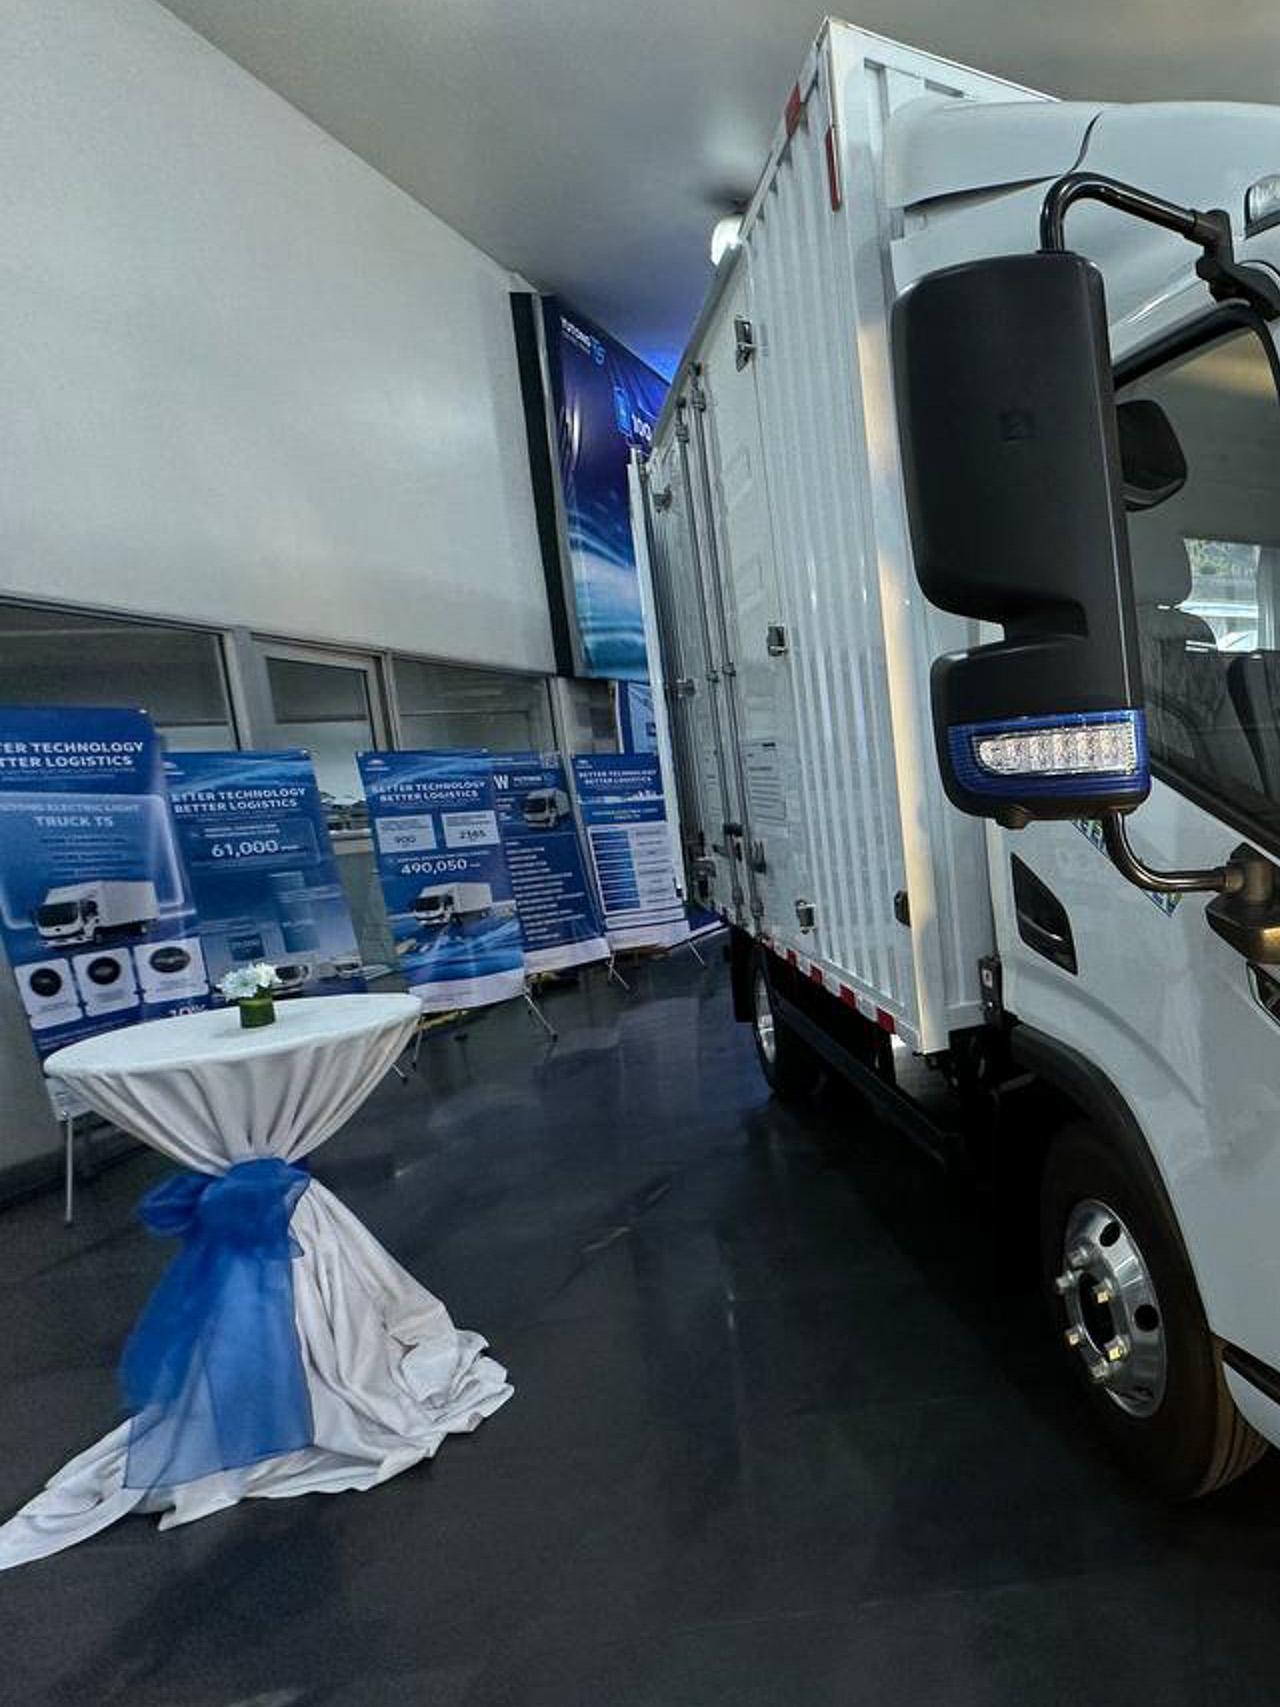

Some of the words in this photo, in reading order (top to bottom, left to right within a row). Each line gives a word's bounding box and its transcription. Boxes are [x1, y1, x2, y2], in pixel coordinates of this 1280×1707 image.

[32, 741, 144, 753] TECHNOLOGY
[46, 755, 134, 767] LOGISTICS
[415, 781, 485, 791] TECHNOLOGY
[218, 787, 307, 800] TECHNOLOGY
[379, 791, 421, 802] BETTER
[423, 789, 479, 800] LOGISTICS
[174, 802, 227, 814] BETTER
[229, 799, 298, 811] LOGISTICS
[33, 815, 92, 827] TRUCK
[211, 839, 279, 858] 61,000
[401, 858, 467, 875] 490,050
